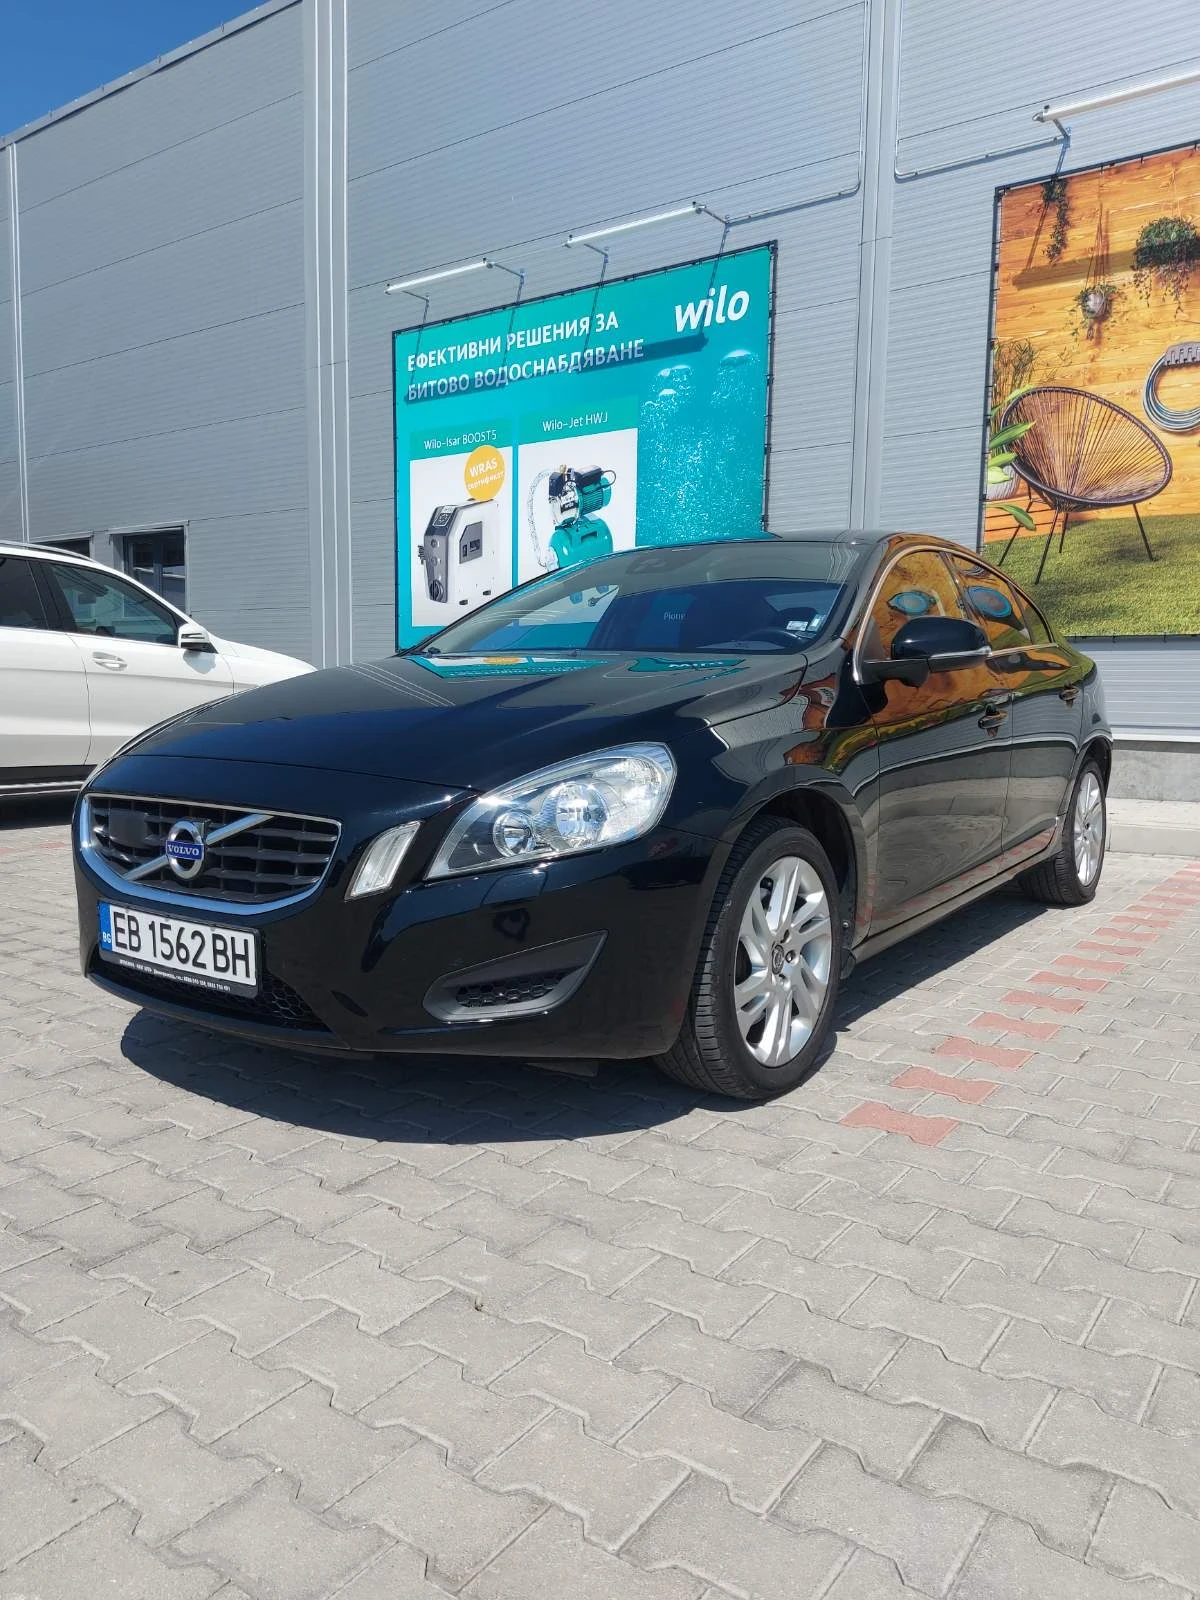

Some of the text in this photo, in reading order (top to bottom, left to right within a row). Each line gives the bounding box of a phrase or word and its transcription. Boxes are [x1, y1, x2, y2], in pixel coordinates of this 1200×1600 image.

[675, 284, 750, 333] wilo
[407, 311, 619, 372] ЕФЕКТИВНИ РЕШЕНИЯ ЗА
[408, 338, 645, 401] БИТОВО ВОДОСНАБДЯВАНЕ
[585, 412, 608, 426] HWJ
[423, 429, 497, 450] Wilo-Isar BOOST5
[470, 457, 498, 478] WRAS
[167, 843, 200, 857] VOLVO
[102, 931, 112, 944] BG
[113, 911, 142, 952] EB
[148, 920, 207, 969] 1562
[211, 933, 251, 978] BH
